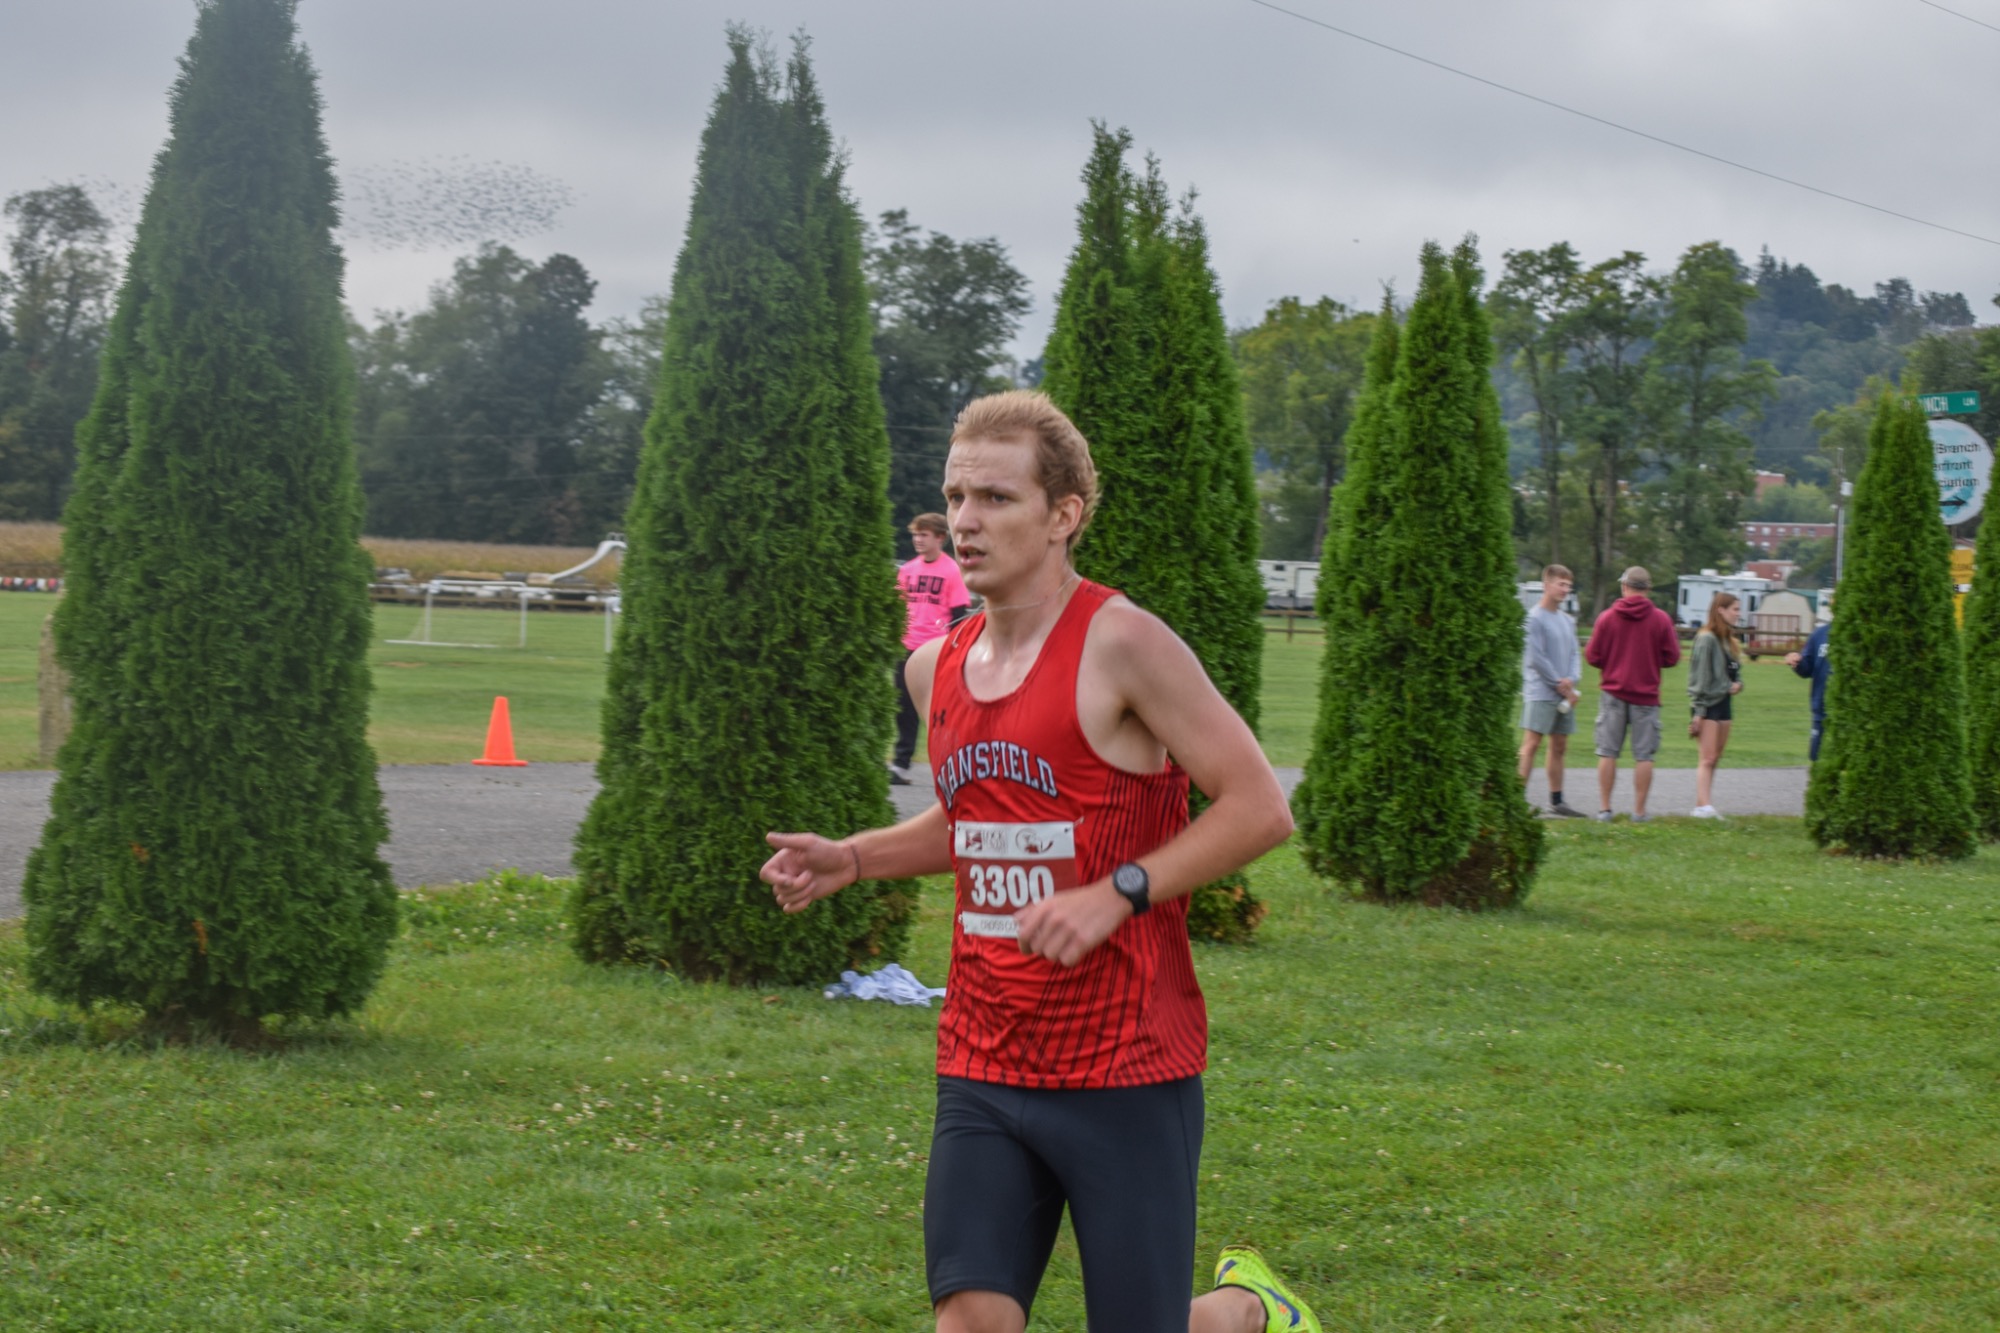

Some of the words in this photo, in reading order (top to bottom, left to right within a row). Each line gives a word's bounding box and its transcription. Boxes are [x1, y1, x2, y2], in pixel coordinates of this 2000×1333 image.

[1936, 443, 1980, 454] Branch
[1933, 459, 1974, 471] erfront
[1940, 477, 1979, 488] ciation
[937, 740, 1059, 810] MANSFIELD
[969, 863, 1055, 908] 3300
